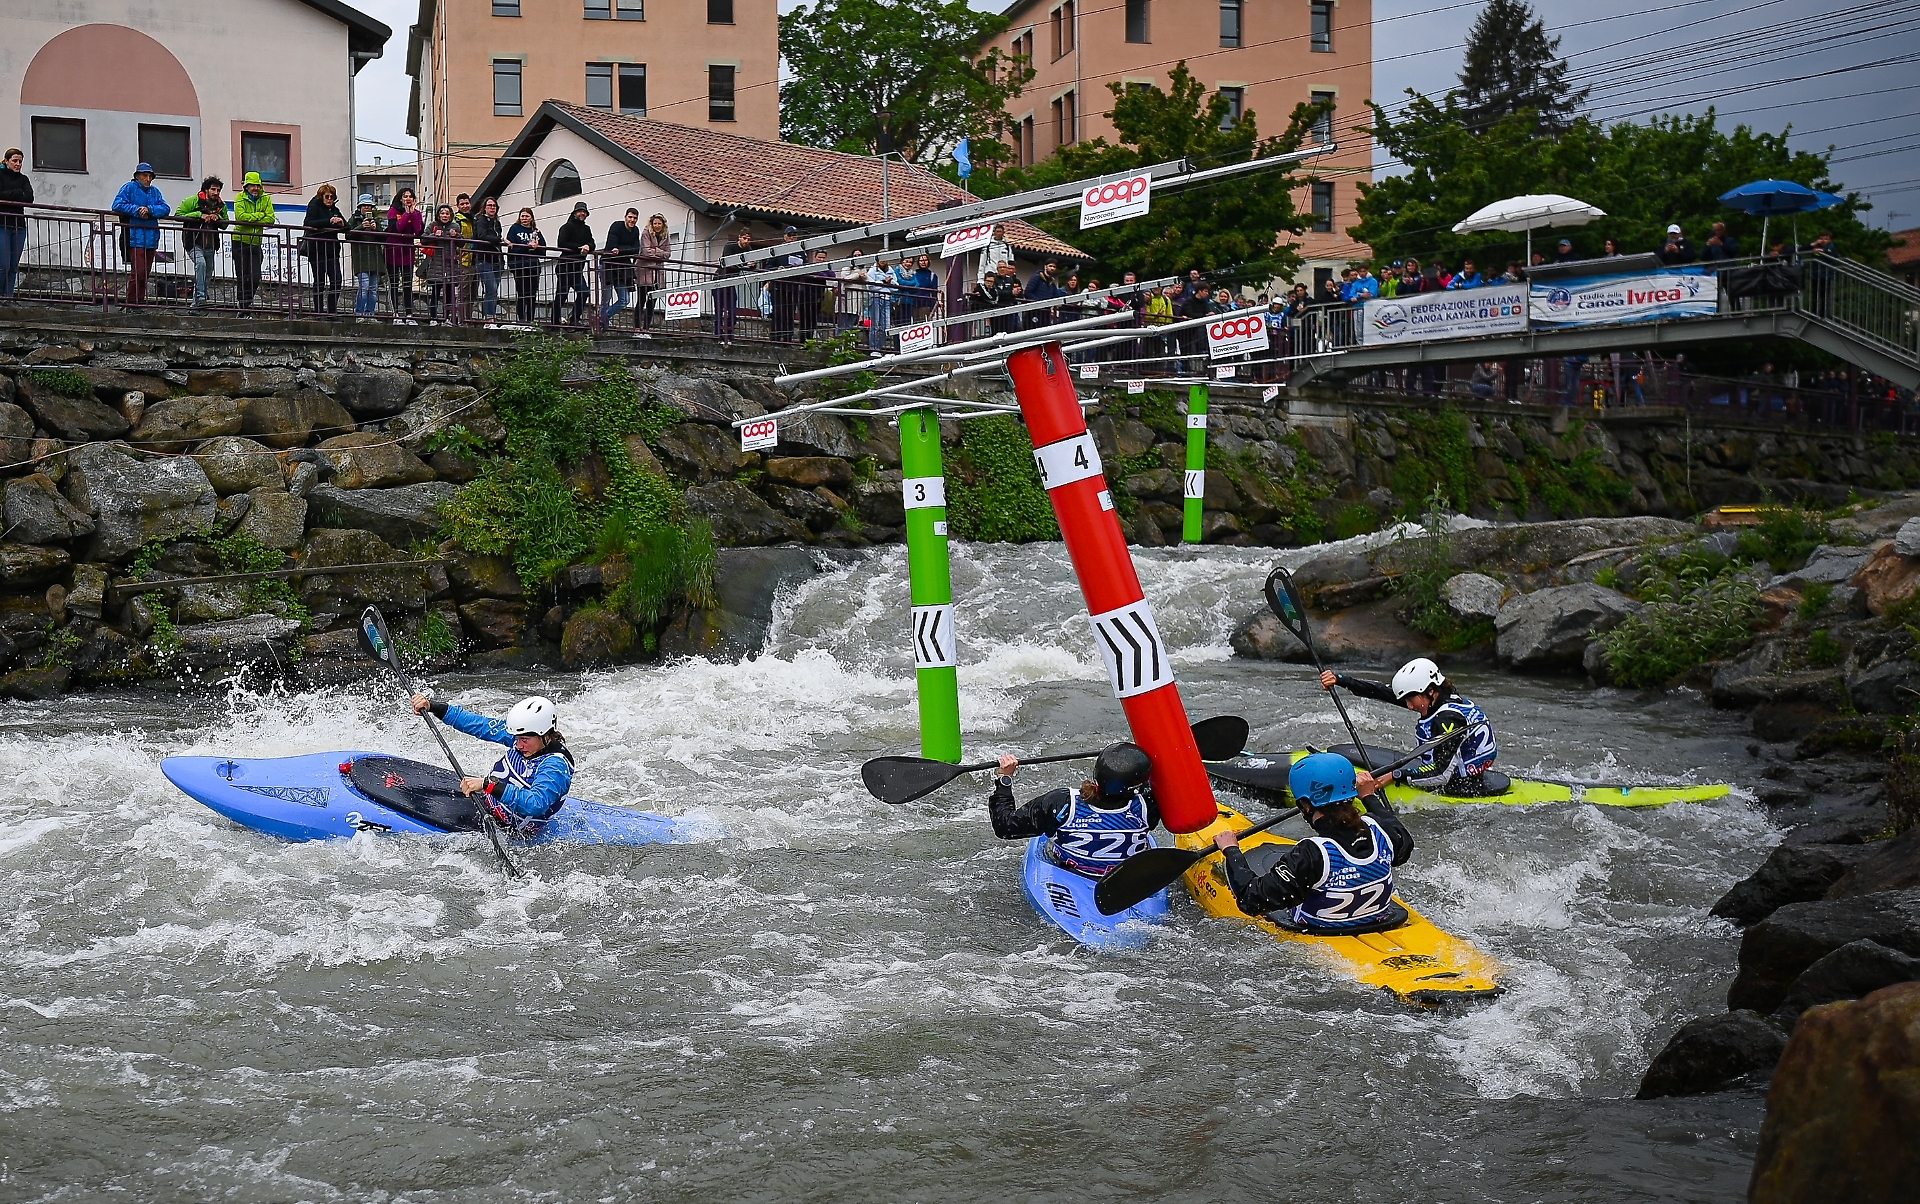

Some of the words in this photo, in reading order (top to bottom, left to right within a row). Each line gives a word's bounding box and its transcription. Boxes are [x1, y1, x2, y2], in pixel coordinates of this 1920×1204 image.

[1085, 177, 1147, 207] coop
[946, 224, 991, 244] coop
[667, 291, 699, 307] coop
[1410, 300, 1476, 314] FEDERAZIONE
[1478, 295, 1522, 306] ITALIANA
[1627, 287, 1681, 305] Ivrea
[1411, 312, 1443, 324] CANOA
[1445, 310, 1477, 321] KAYAK
[901, 325, 932, 342] coop
[1210, 316, 1263, 340] coop
[1212, 345, 1240, 353] Novacoop
[743, 421, 775, 437] coop
[1193, 417, 1199, 426] 2
[1074, 444, 1089, 470] 4
[914, 483, 926, 502] 3
[1062, 832, 1147, 857] 228
[1316, 881, 1391, 918] 22
